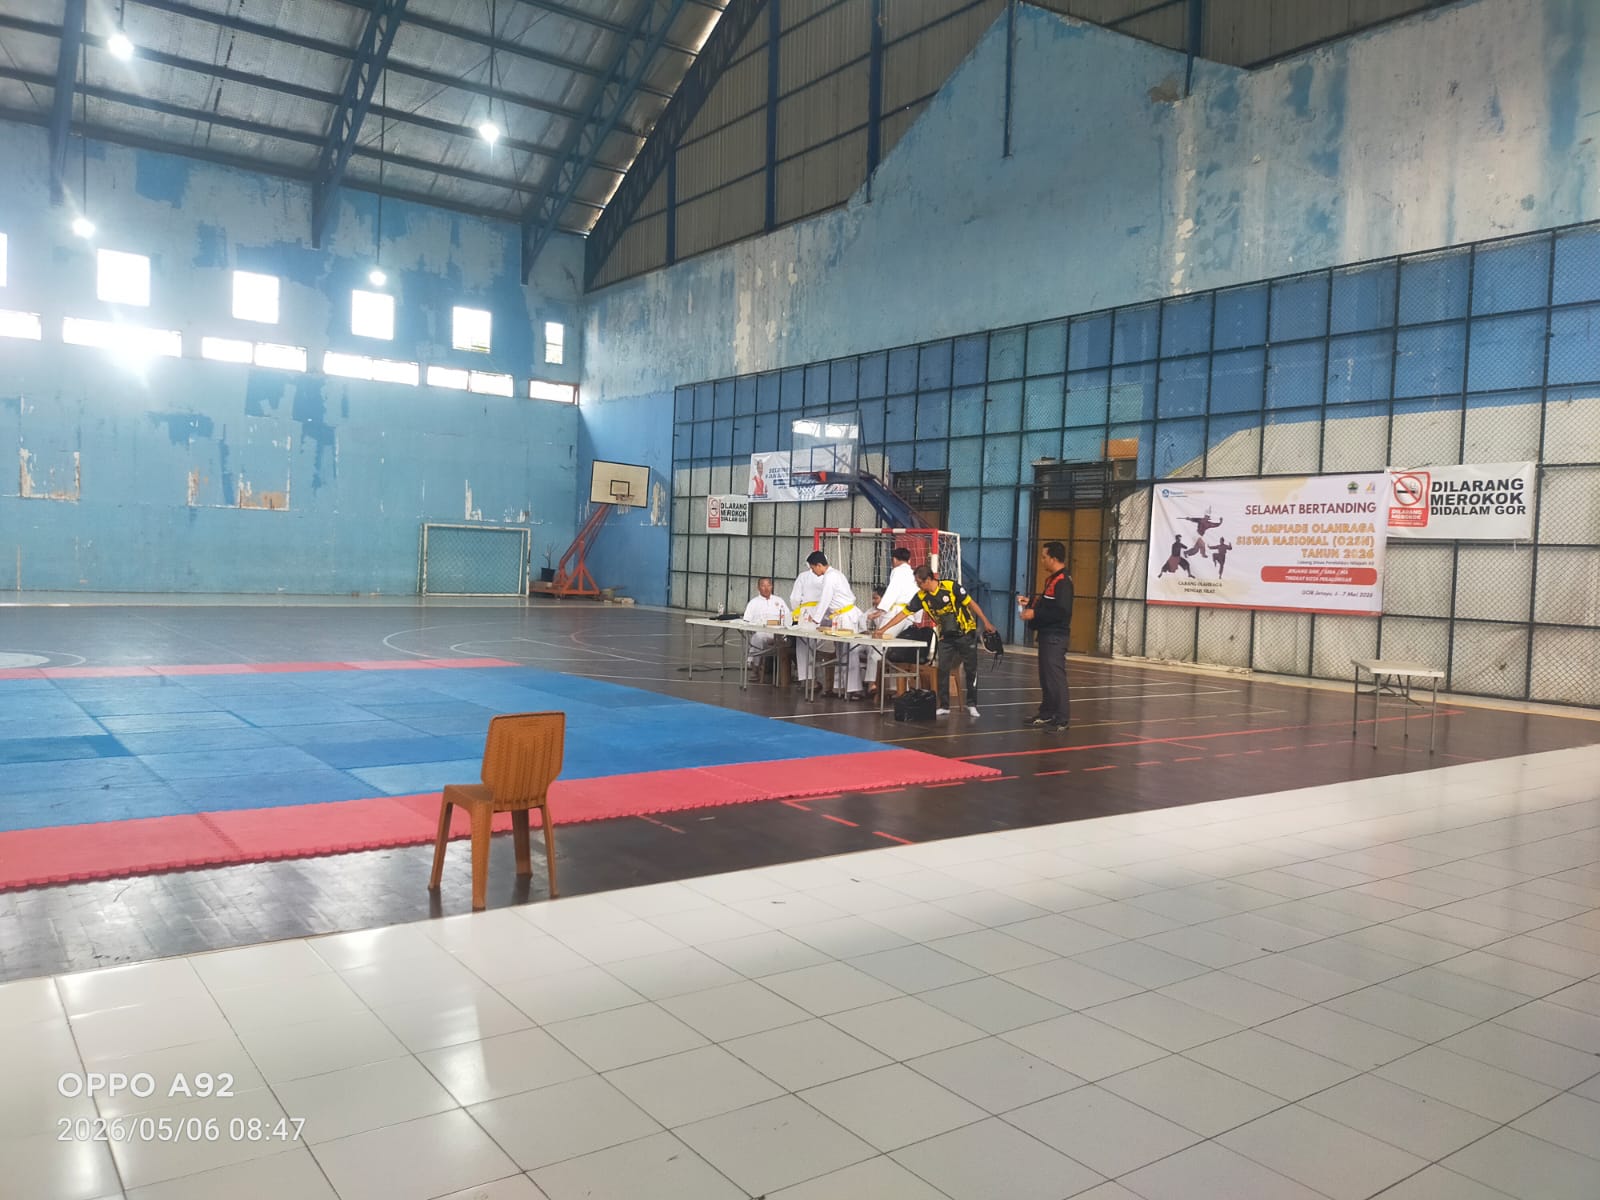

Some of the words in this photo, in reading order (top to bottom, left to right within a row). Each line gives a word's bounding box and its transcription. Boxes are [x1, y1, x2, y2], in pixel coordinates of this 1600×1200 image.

[1431, 478, 1524, 493] DILARANG
[1430, 492, 1524, 506] MEROKOK
[1245, 504, 1297, 515] SELAMAT
[1299, 502, 1377, 514] BERTANDING
[1430, 505, 1490, 516] DIDALAM
[1494, 505, 1526, 515] GOR
[1251, 524, 1309, 534] OLIMPIADE
[1311, 523, 1376, 533] OLAHRAGA
[1236, 536, 1270, 546] SISWA
[1272, 536, 1329, 546] NASIONAL
[1301, 549, 1340, 559] TAHUN
